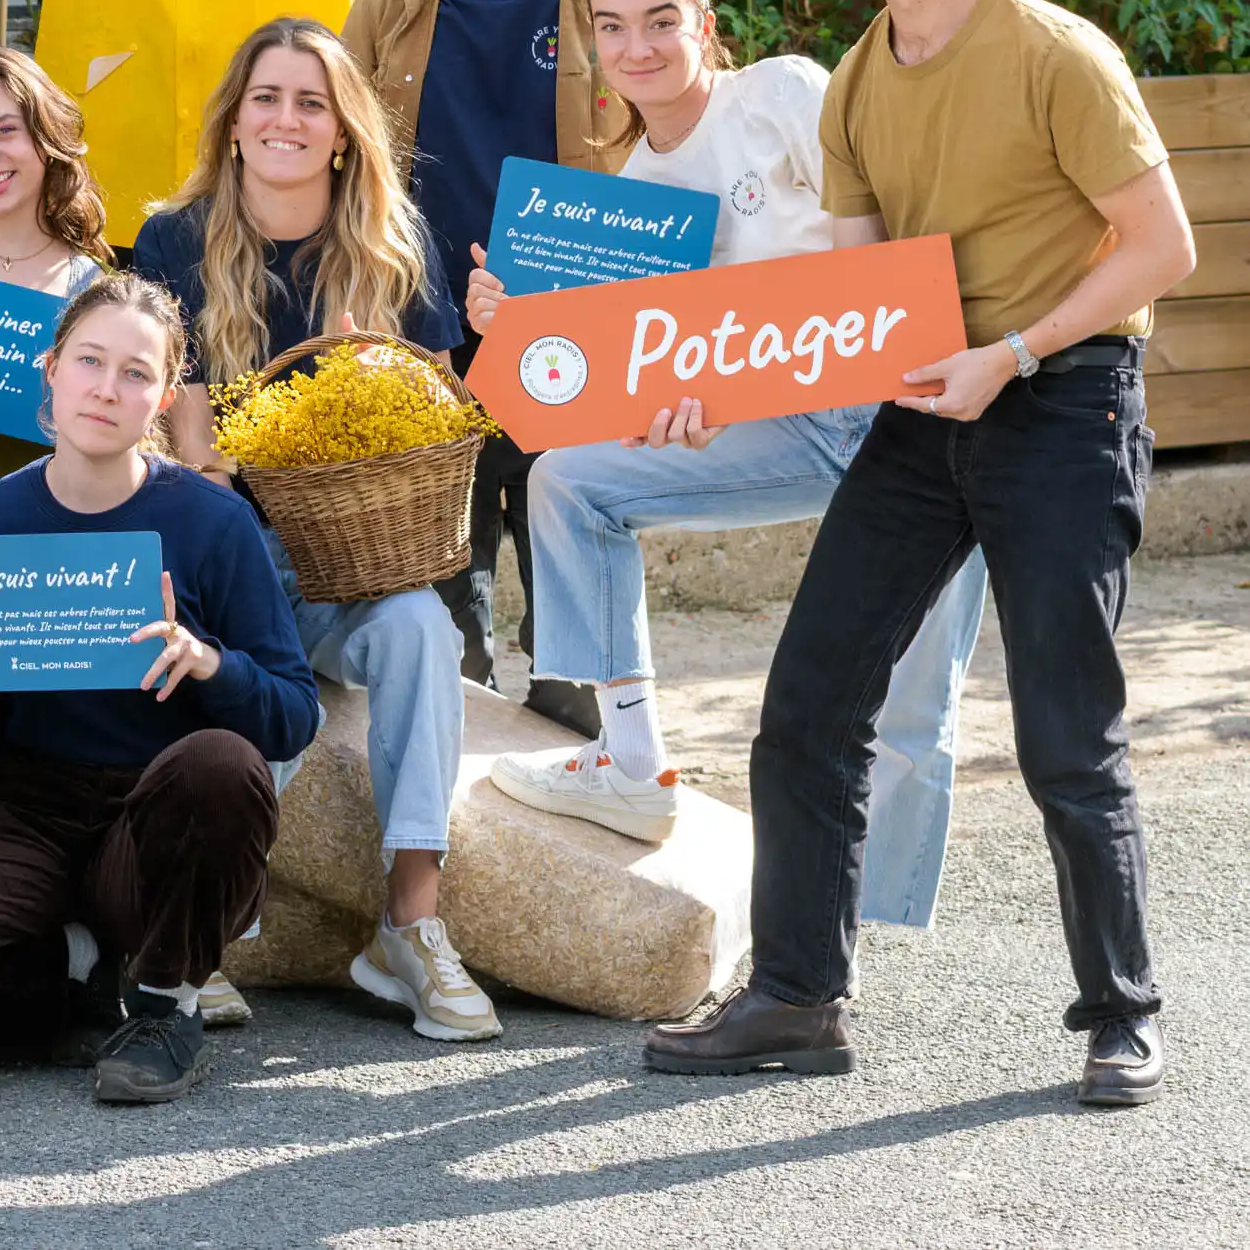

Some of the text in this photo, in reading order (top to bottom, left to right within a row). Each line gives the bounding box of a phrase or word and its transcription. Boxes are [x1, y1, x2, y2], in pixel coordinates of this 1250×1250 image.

[533, 26, 550, 42] ARE
[535, 58, 558, 70] RADI
[517, 187, 694, 240] Je suis vivant !
[506, 227, 518, 238] On
[532, 232, 556, 245] dirait
[556, 239, 572, 248] pas
[573, 242, 593, 252] mais
[608, 248, 636, 260] arbres
[636, 252, 672, 266] fruitiers
[672, 261, 692, 270] sont
[510, 242, 524, 252] bel
[524, 244, 534, 254] et
[534, 246, 552, 258] bien
[586, 255, 600, 266] Ils
[600, 260, 628, 272] misent
[628, 265, 647, 276] tout
[514, 258, 545, 270] racines
[544, 264, 564, 273] pour
[564, 267, 588, 278] mieux
[536, 340, 554, 350] MON
[626, 305, 908, 398] Potager
[46, 562, 119, 589] vivant
[123, 558, 136, 586] !
[4, 610, 20, 622] pas
[22, 610, 42, 618] mais
[60, 606, 88, 618] arbres
[89, 606, 124, 618] fruitiers
[126, 607, 146, 616] sont
[38, 621, 52, 632] Ils
[54, 620, 82, 631] misent
[84, 622, 102, 631] tout
[119, 620, 140, 630] leurs
[20, 638, 42, 646] mieux
[43, 637, 76, 648] pousser
[42, 662, 62, 670] MON
